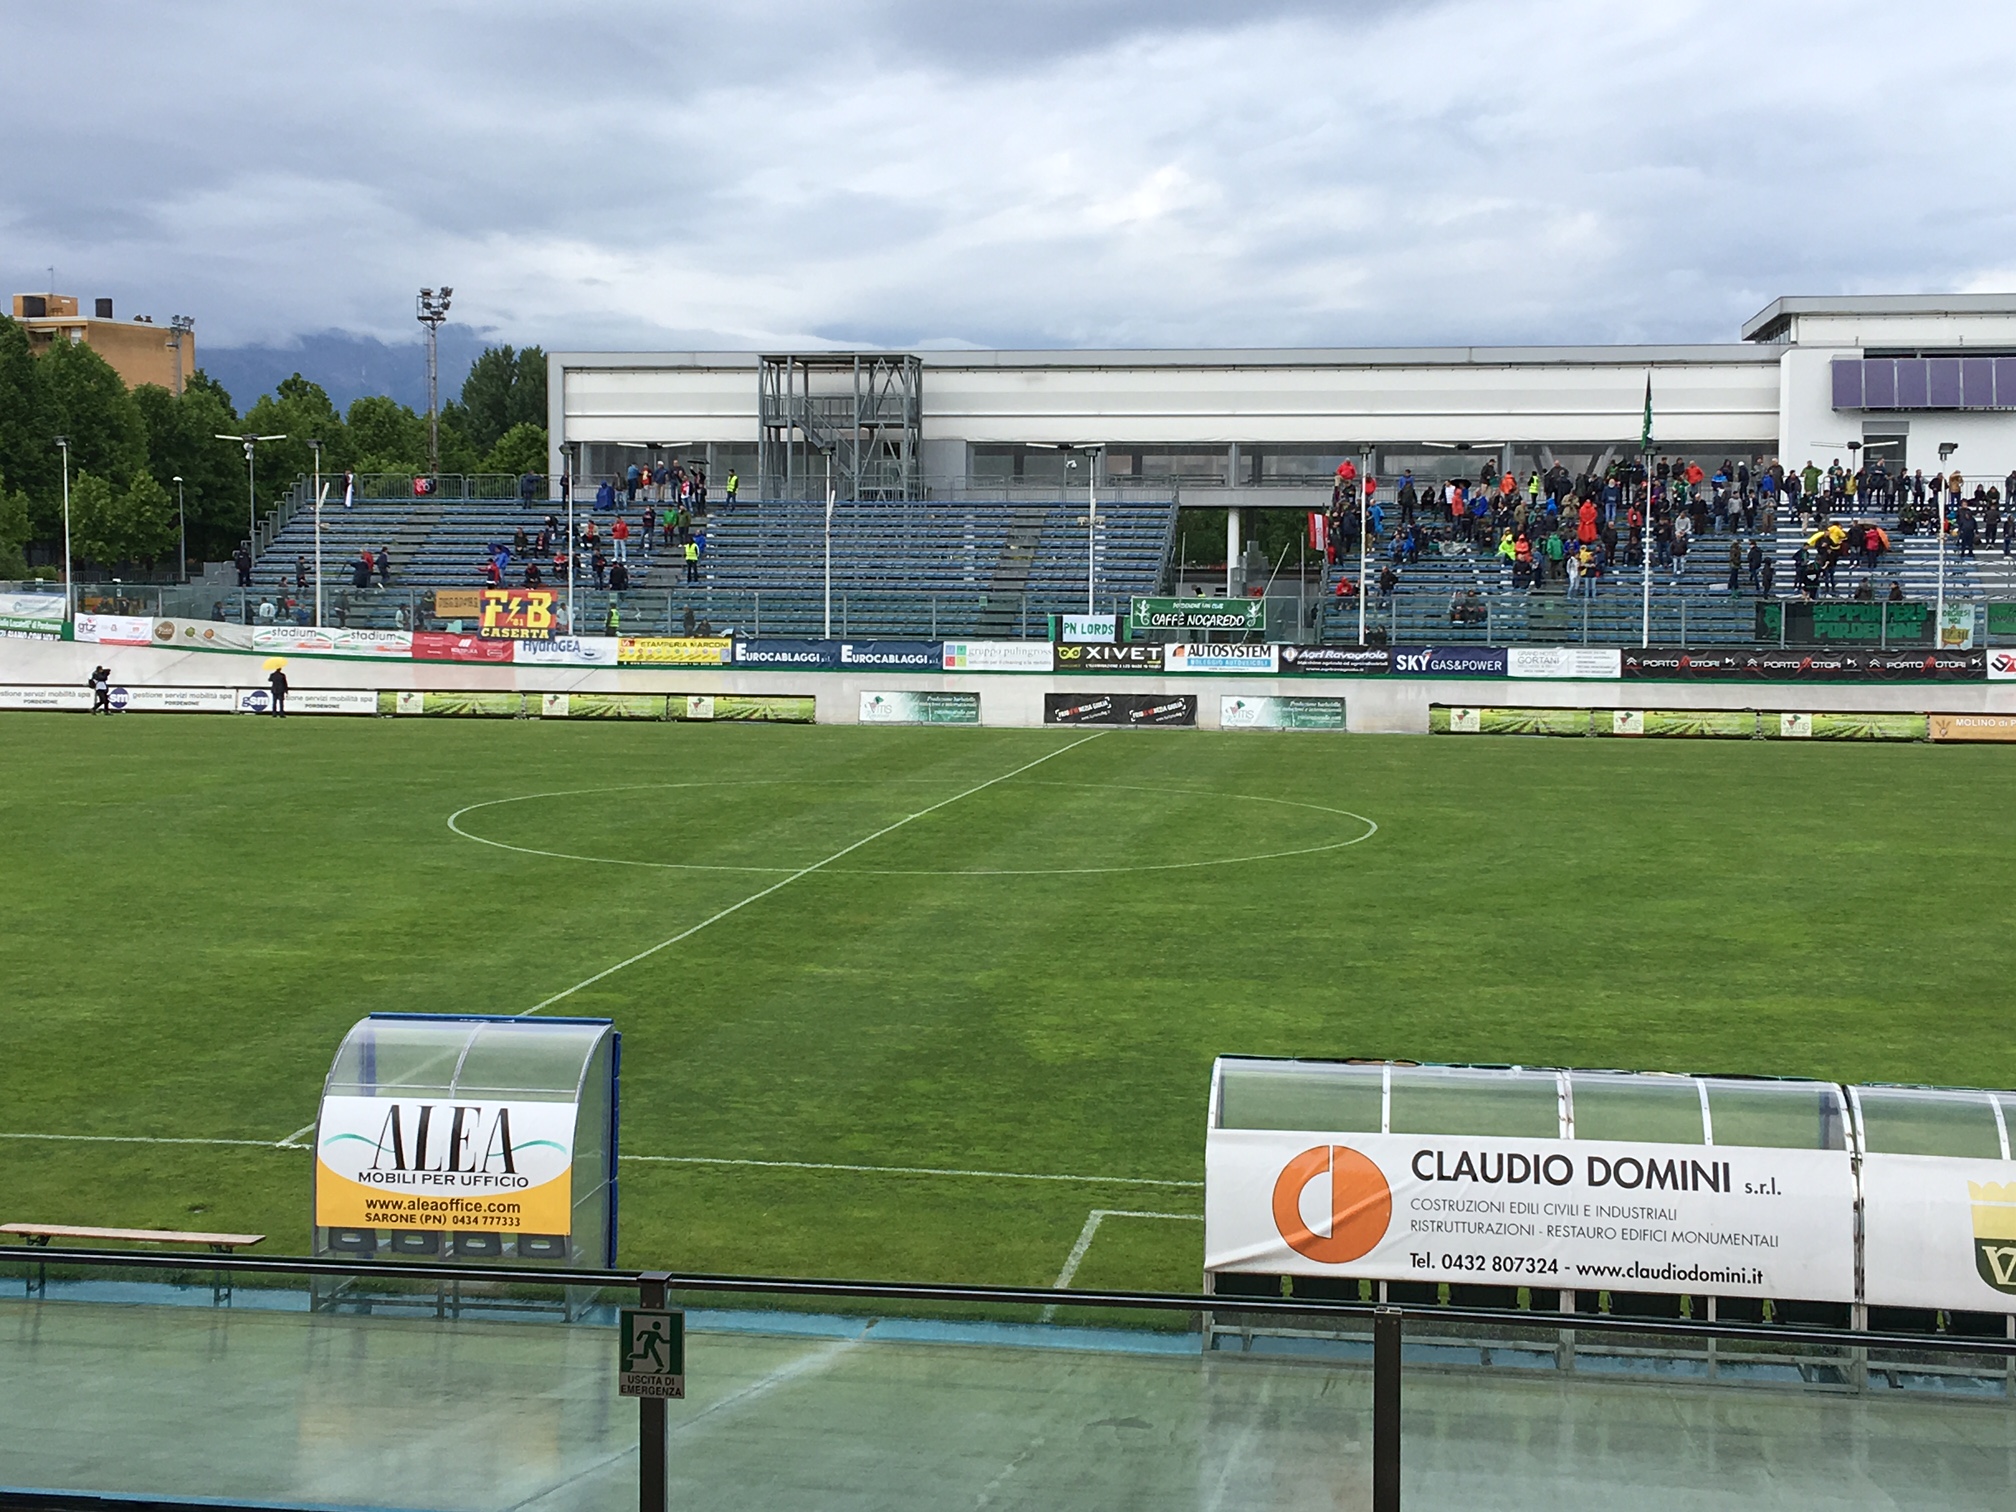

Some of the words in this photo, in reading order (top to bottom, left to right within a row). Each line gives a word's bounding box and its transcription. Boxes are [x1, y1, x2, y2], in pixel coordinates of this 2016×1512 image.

[527, 592, 552, 628] B
[1186, 614, 1245, 627] NOGAREDO
[78, 622, 97, 633] gtz
[272, 627, 317, 638] stadium
[480, 627, 549, 639] CASERTA
[1063, 623, 1076, 634] PN
[1081, 623, 1114, 635] LORDS
[1813, 622, 1921, 638] PORDENONE
[351, 631, 397, 641] stadium
[522, 640, 581, 655] HydroGEA
[735, 643, 820, 662] EUROCABLAGGI
[968, 646, 1000, 658] gruppo
[1003, 645, 1053, 658] pulingross
[1086, 646, 1163, 660] XIVET
[1188, 645, 1271, 658] AUTOSYSTEM
[841, 645, 927, 664] EUROCABLAGGI
[1299, 650, 1325, 660] Agri
[1325, 650, 1388, 660] Ravagnolo
[1517, 656, 1560, 664] GORTANI
[1190, 659, 1224, 667] NOLEGGIO
[1225, 659, 1269, 667] AUTOVEICOLI
[1396, 654, 1431, 671] SKY
[1430, 660, 1502, 671] GAS&POWER
[1642, 660, 1678, 668] PORTO
[1763, 660, 1800, 668] PORTO
[1886, 660, 1923, 668] PORTO
[132, 692, 163, 700] gestione
[1956, 719, 1996, 727] MOLINO
[1998, 719, 2007, 727] di
[367, 1104, 519, 1174] ALEA
[1411, 1149, 1574, 1187] CLAUDIO
[1586, 1156, 1731, 1193] DOMINI
[1744, 1177, 1782, 1196] s.r.l.
[358, 1171, 415, 1185] MOBILI
[421, 1174, 455, 1186] PER
[460, 1175, 529, 1188] UFFICIO
[365, 1197, 521, 1214] www.aleaoffice.com
[1410, 1197, 1505, 1213] COSTRUZIONI
[1510, 1202, 1539, 1215] EDILI
[1543, 1202, 1580, 1217] CIVILI
[1583, 1205, 1591, 1217] E
[1596, 1204, 1678, 1222] INDUSTRIALI
[364, 1212, 417, 1224] SARONE
[419, 1214, 447, 1226] (PN)
[452, 1215, 479, 1226] 0434
[482, 1215, 521, 1227] 777333
[1410, 1219, 1535, 1237] RISTRUTTURAZIONI
[1546, 1227, 1617, 1240] RESTAURO
[1621, 1229, 1667, 1242] EDIFICI
[1671, 1231, 1779, 1248] MONUMENTALI
[1410, 1252, 1436, 1270] Tel.
[1441, 1253, 1488, 1273] 0432
[1491, 1256, 1559, 1275] 807324
[1576, 1262, 1763, 1285] www.claudiodomini.it
[627, 1375, 662, 1385] USCITA
[664, 1376, 675, 1386] DI
[620, 1384, 682, 1396] EMERGENZA
